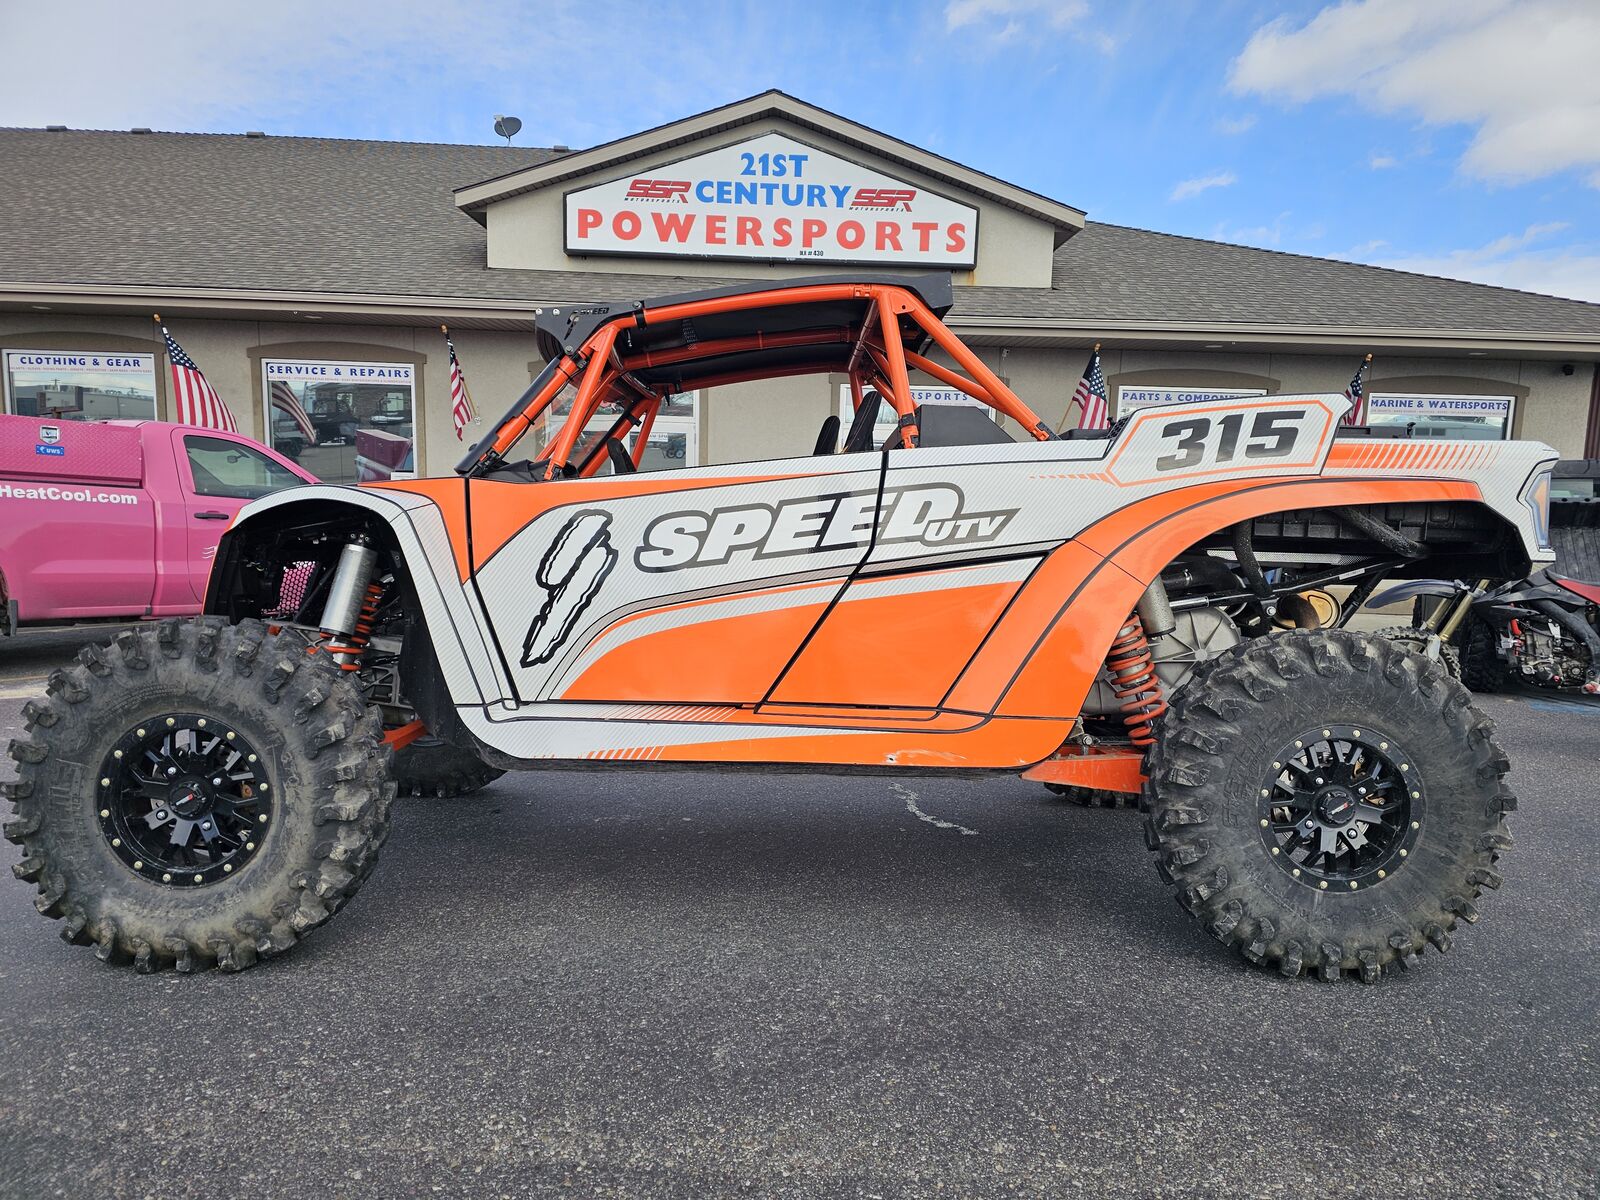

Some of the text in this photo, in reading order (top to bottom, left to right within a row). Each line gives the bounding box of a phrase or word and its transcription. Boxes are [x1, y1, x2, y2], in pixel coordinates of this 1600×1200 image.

[739, 152, 809, 178] 21ST
[626, 179, 692, 203] SSR
[694, 179, 852, 209] CENTURY
[851, 188, 917, 212] SSR
[577, 208, 966, 253] POWERSPORTS
[579, 307, 610, 316] SPEED
[20, 356, 141, 367] CLOTHING & GEAR
[269, 365, 410, 378] SERVICE & REPAIRS
[911, 392, 969, 401] RSPORTS
[1122, 392, 1239, 402] PARTS & COMPO
[1370, 399, 1508, 410] MARINE & WATERSPORTS
[1156, 410, 1306, 471] 315
[635, 482, 1016, 572] SPEED UTV
